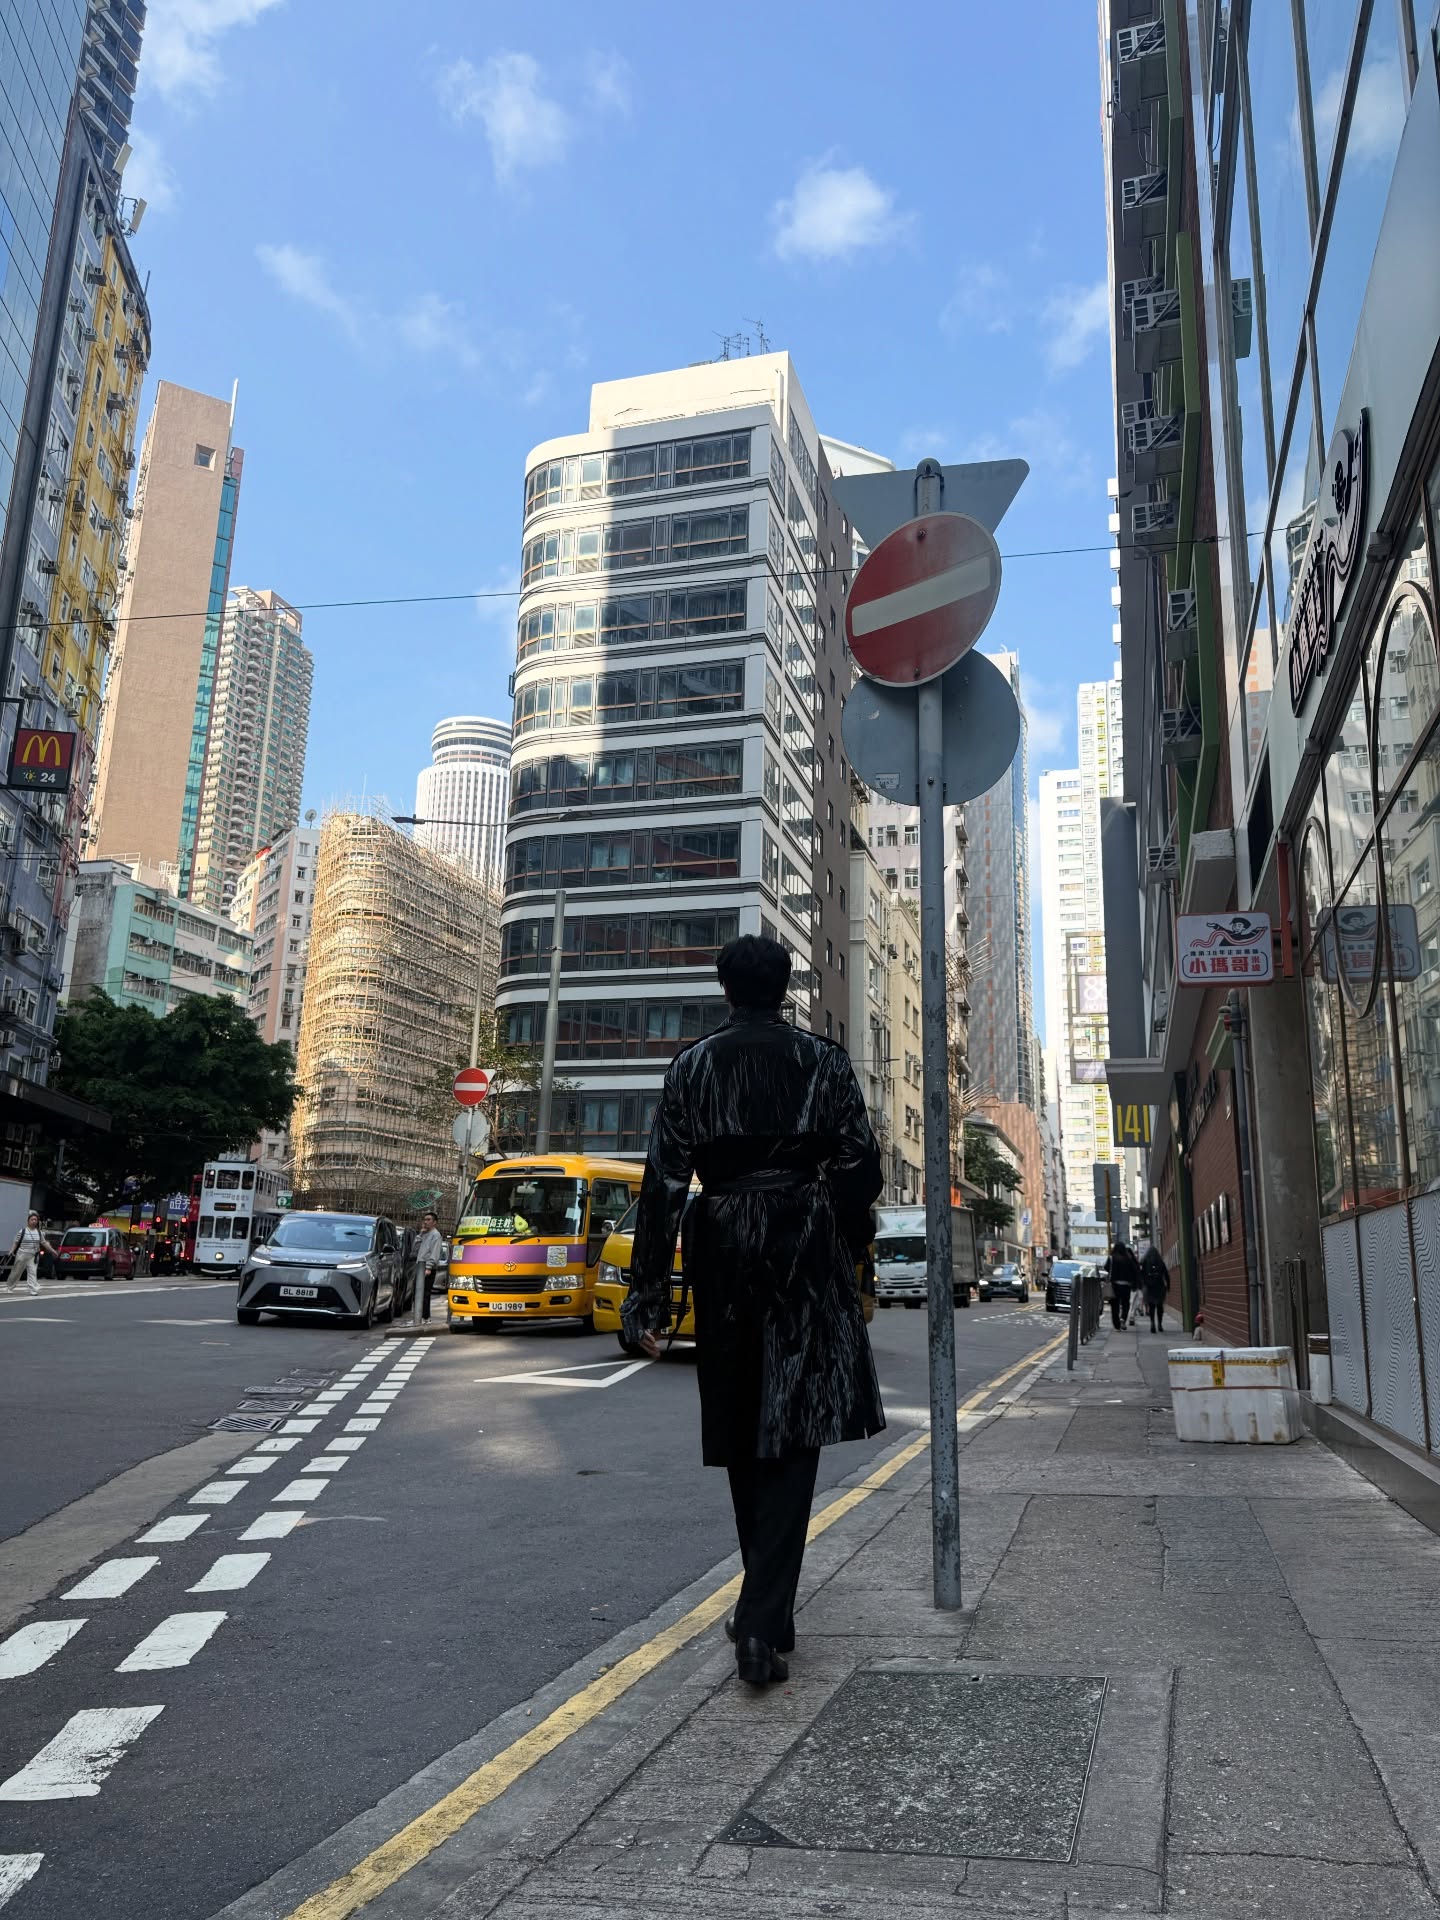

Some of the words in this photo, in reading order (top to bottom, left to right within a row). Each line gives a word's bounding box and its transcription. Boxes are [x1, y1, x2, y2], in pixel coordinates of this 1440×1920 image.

[40, 772, 56, 783] 24
[1189, 957, 1249, 974] 小瑪哥
[1116, 1104, 1150, 1143] 141
[283, 1287, 294, 1296] BL
[295, 1288, 314, 1297] 8818
[491, 1302, 503, 1310] UG
[504, 1302, 523, 1311] 1989
